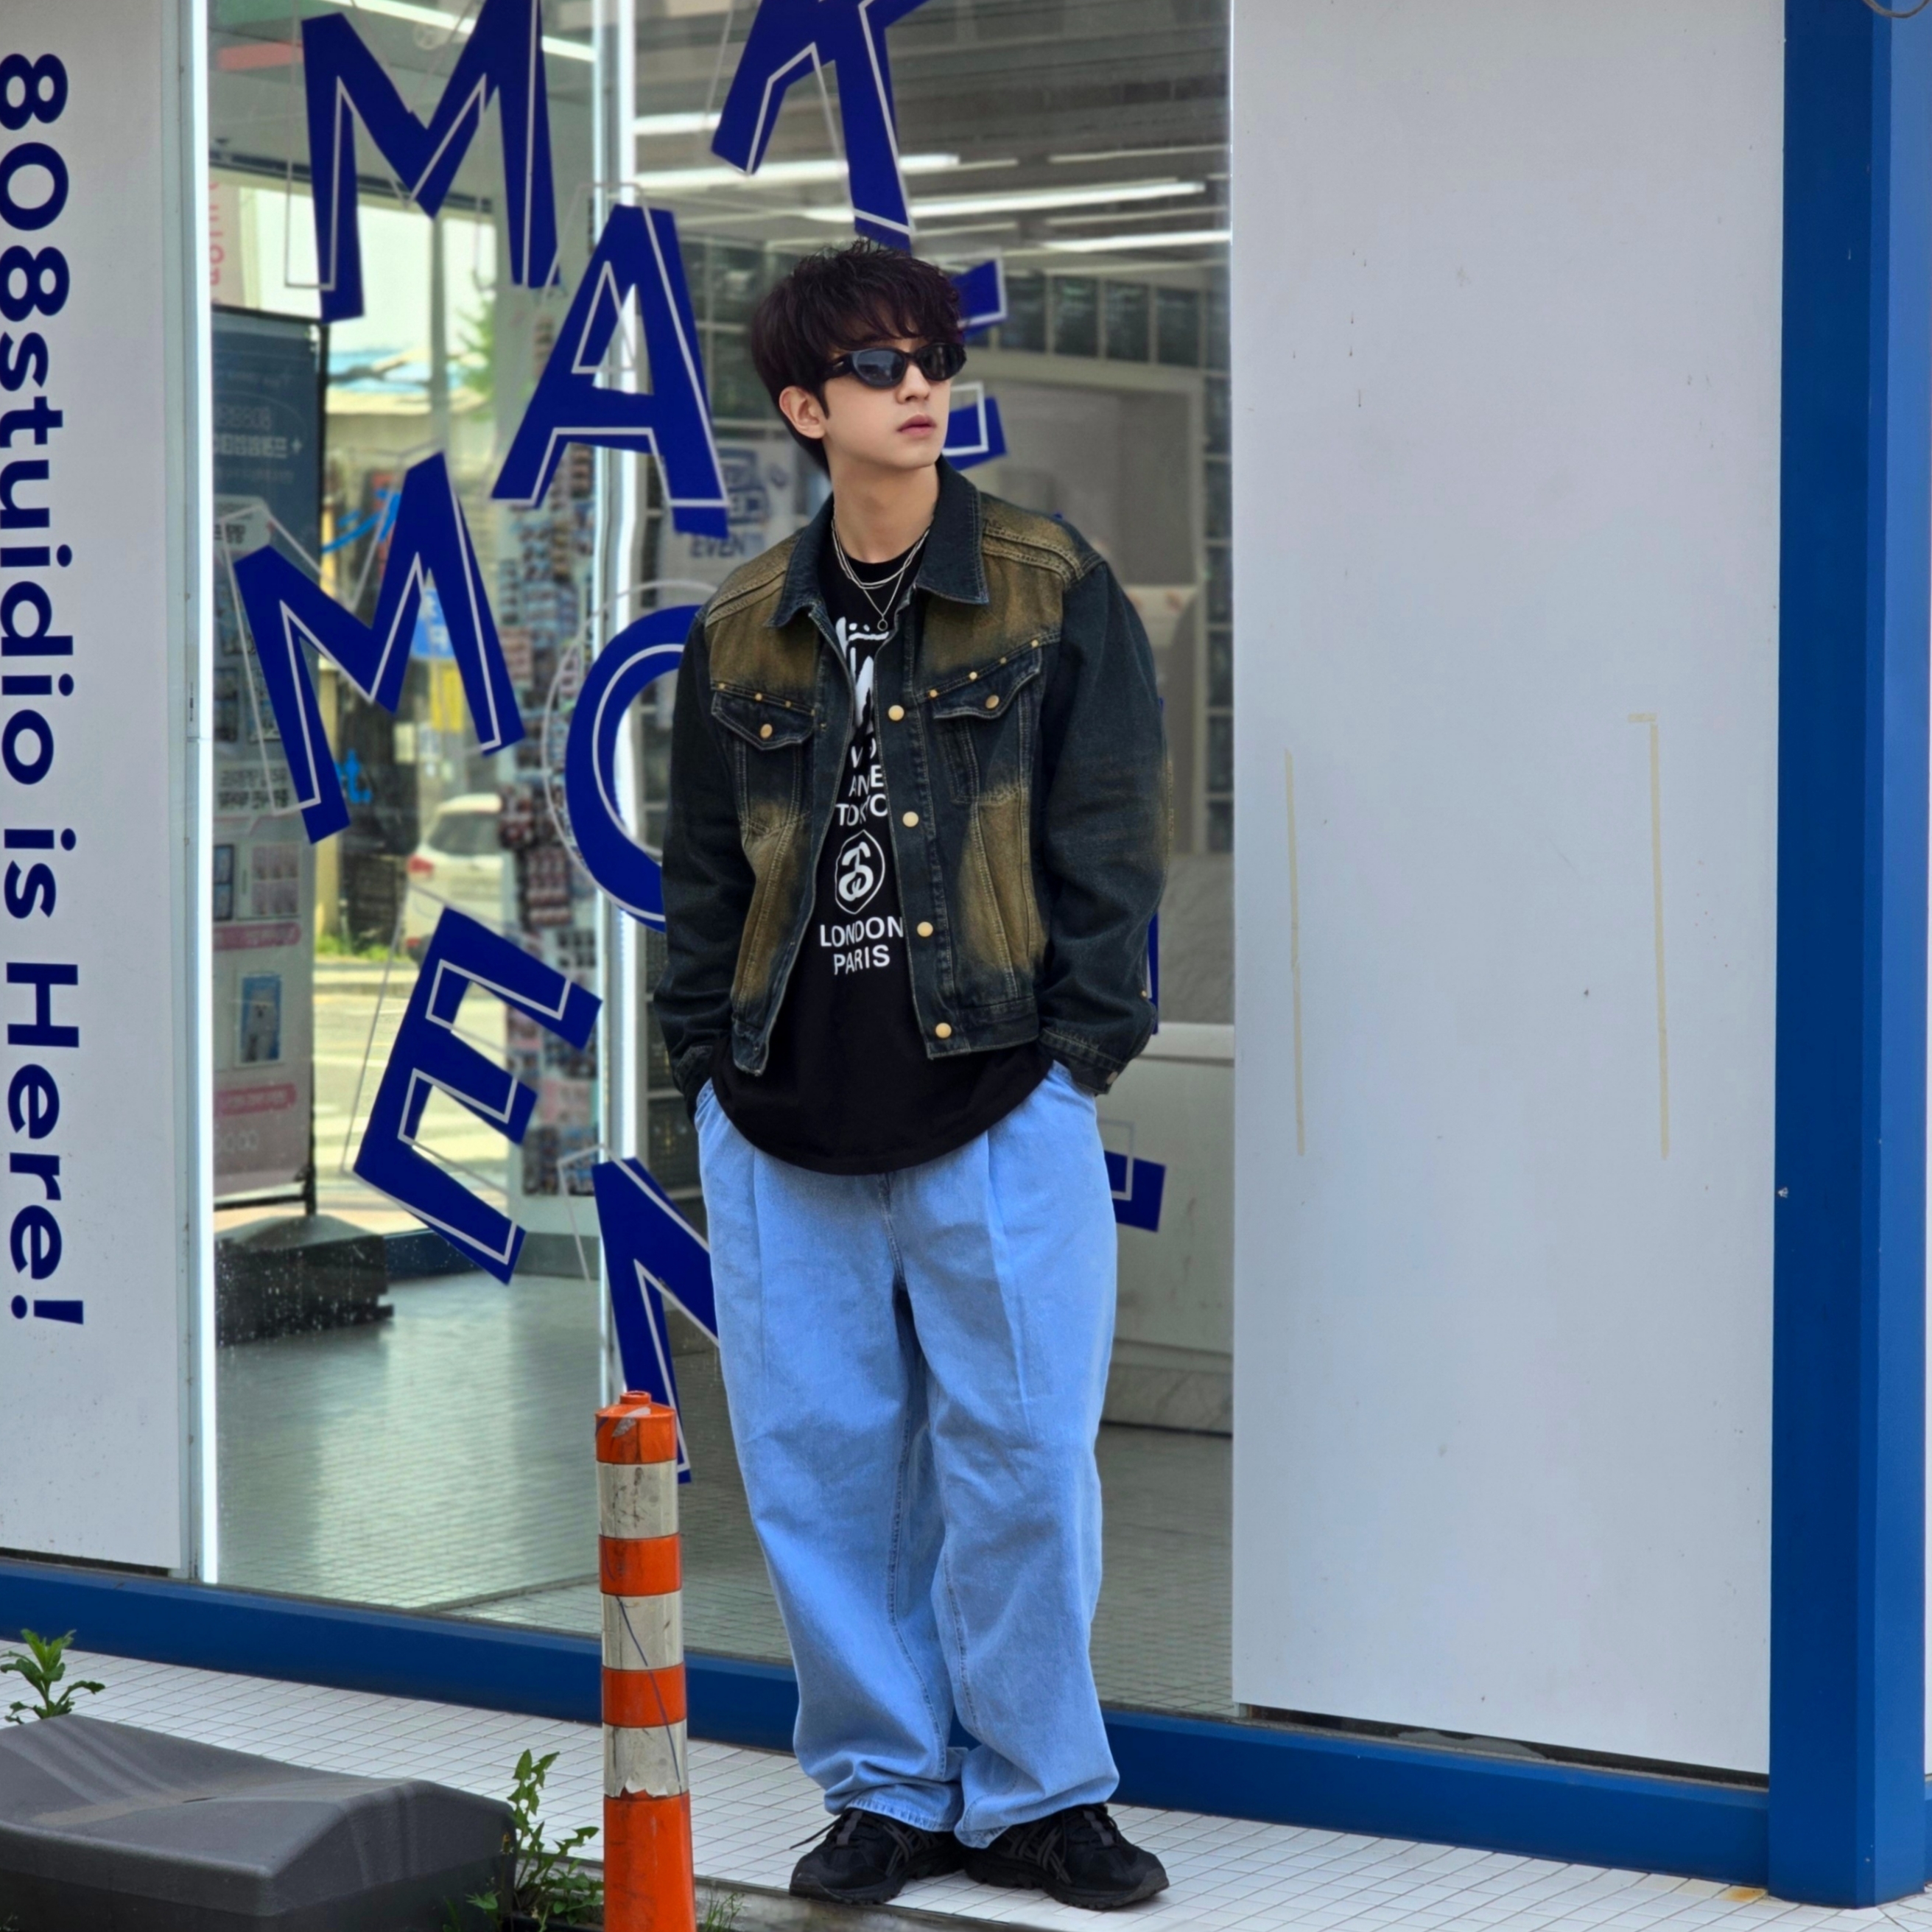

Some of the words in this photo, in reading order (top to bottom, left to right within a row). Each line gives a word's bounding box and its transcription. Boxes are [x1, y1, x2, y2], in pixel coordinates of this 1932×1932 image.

[4, 813, 77, 919] is
[820, 916, 904, 947] LONDON
[833, 944, 891, 975] PARIS
[6, 962, 84, 1324] Here!
